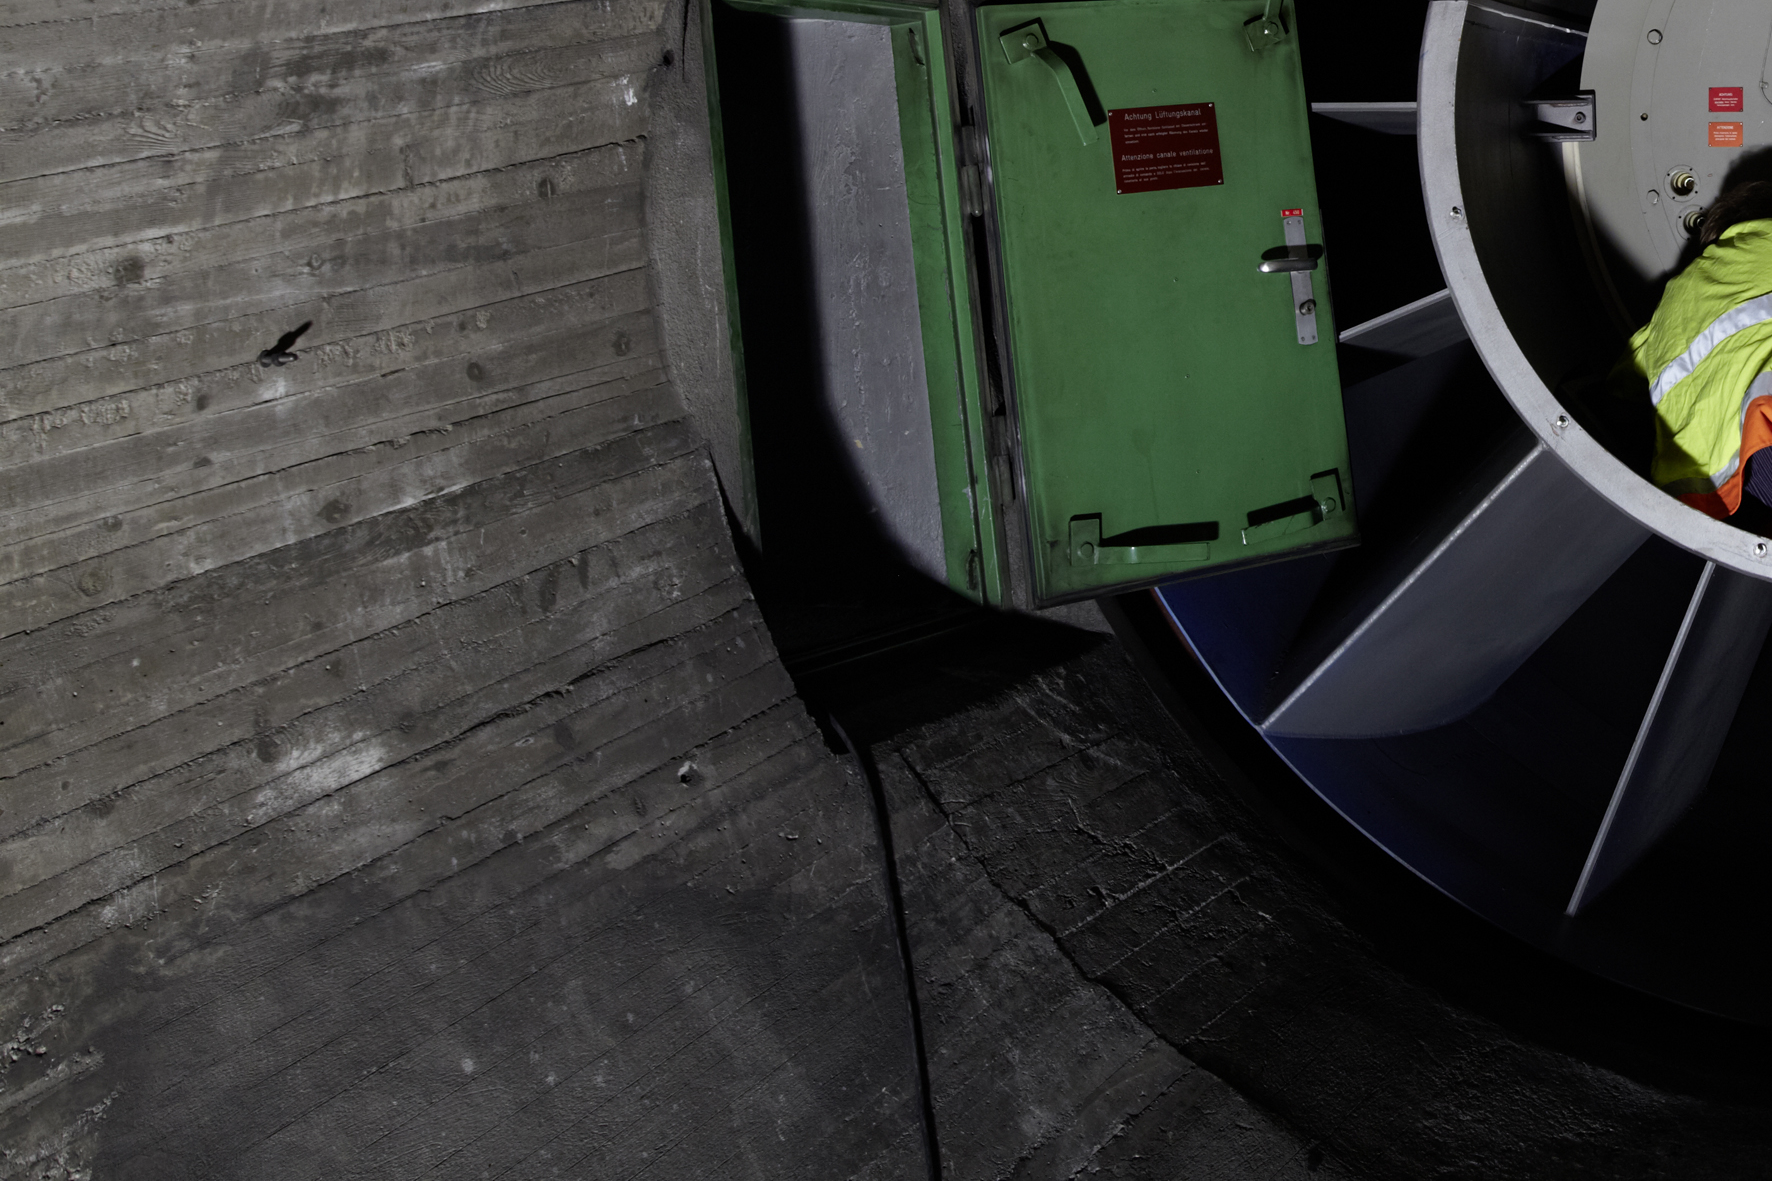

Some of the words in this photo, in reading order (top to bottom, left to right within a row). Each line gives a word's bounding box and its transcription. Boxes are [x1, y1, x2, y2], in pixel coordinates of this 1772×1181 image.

[1124, 113, 1152, 121] Achtung
[1155, 108, 1201, 118] Lüftungskanal
[1121, 153, 1153, 161] Attenzione
[1156, 151, 1177, 159] canale
[1179, 148, 1213, 156] ventilatione
